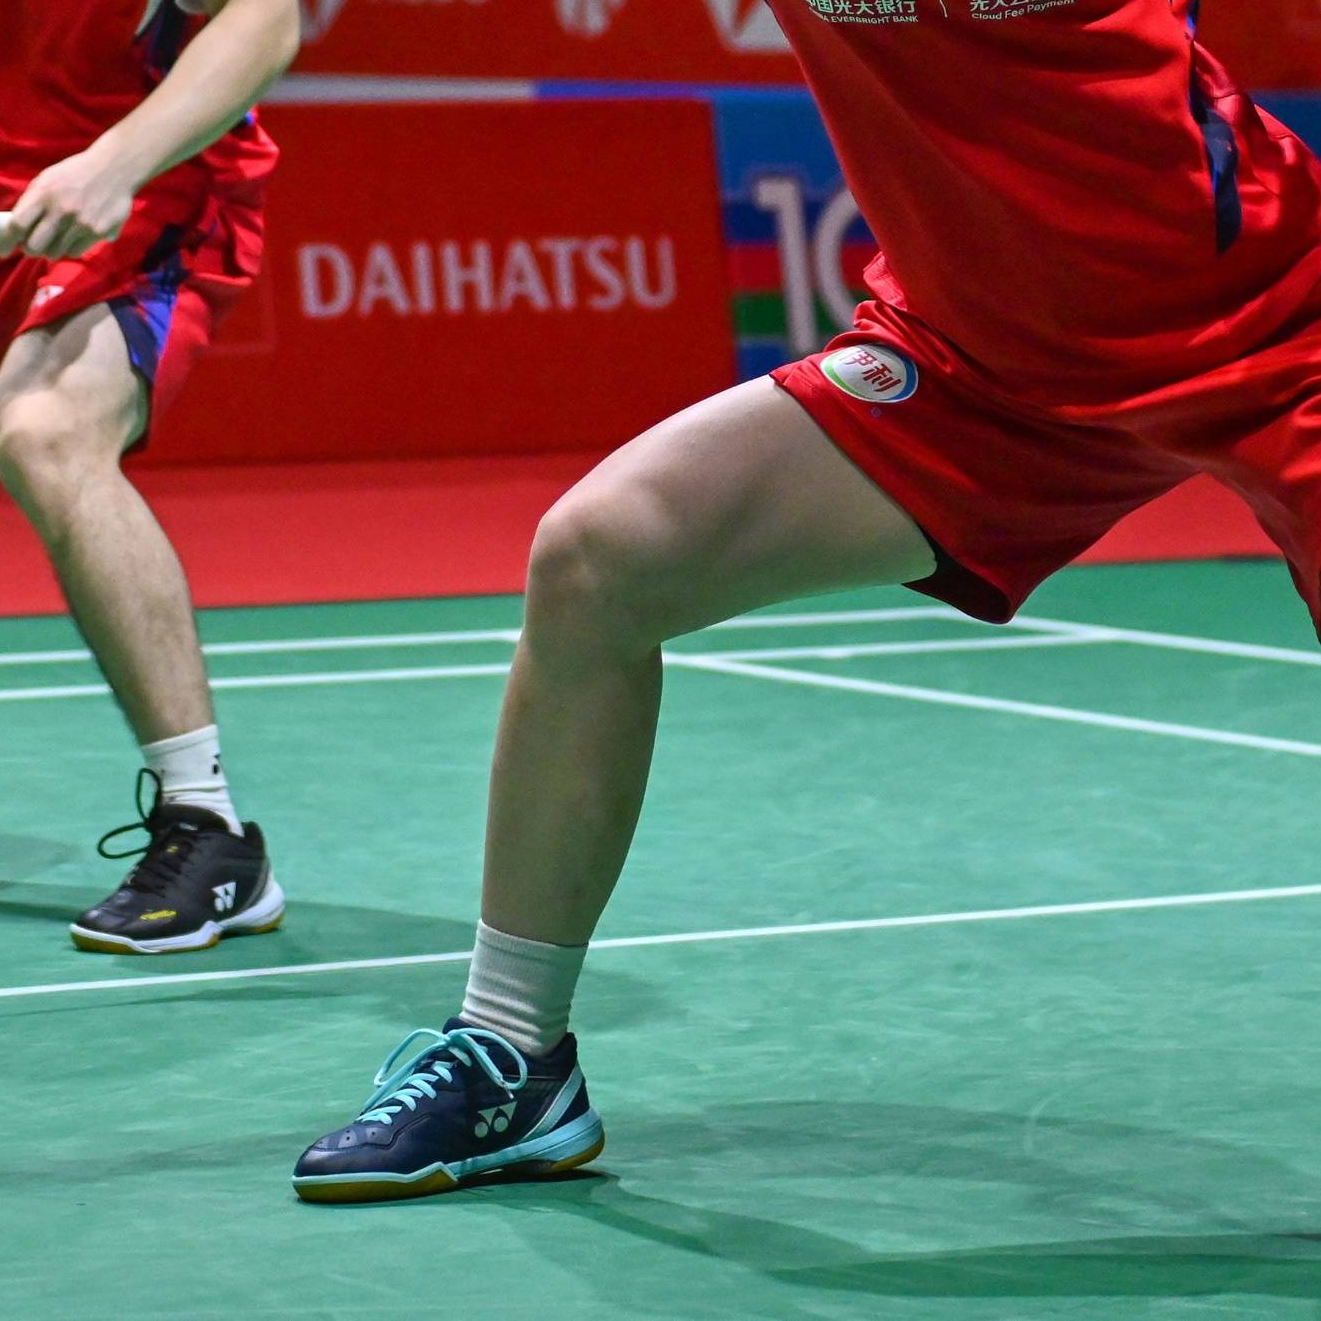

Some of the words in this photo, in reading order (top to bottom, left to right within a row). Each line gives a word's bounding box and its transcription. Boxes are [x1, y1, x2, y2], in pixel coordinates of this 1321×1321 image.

[830, 15, 890, 24] EVERBRIGHT
[892, 15, 919, 23] BANK
[971, 11, 1003, 20] Cloud
[1004, 7, 1025, 19] Fee
[298, 234, 677, 319] DAIHATSU
[838, 349, 903, 393] 伊利
